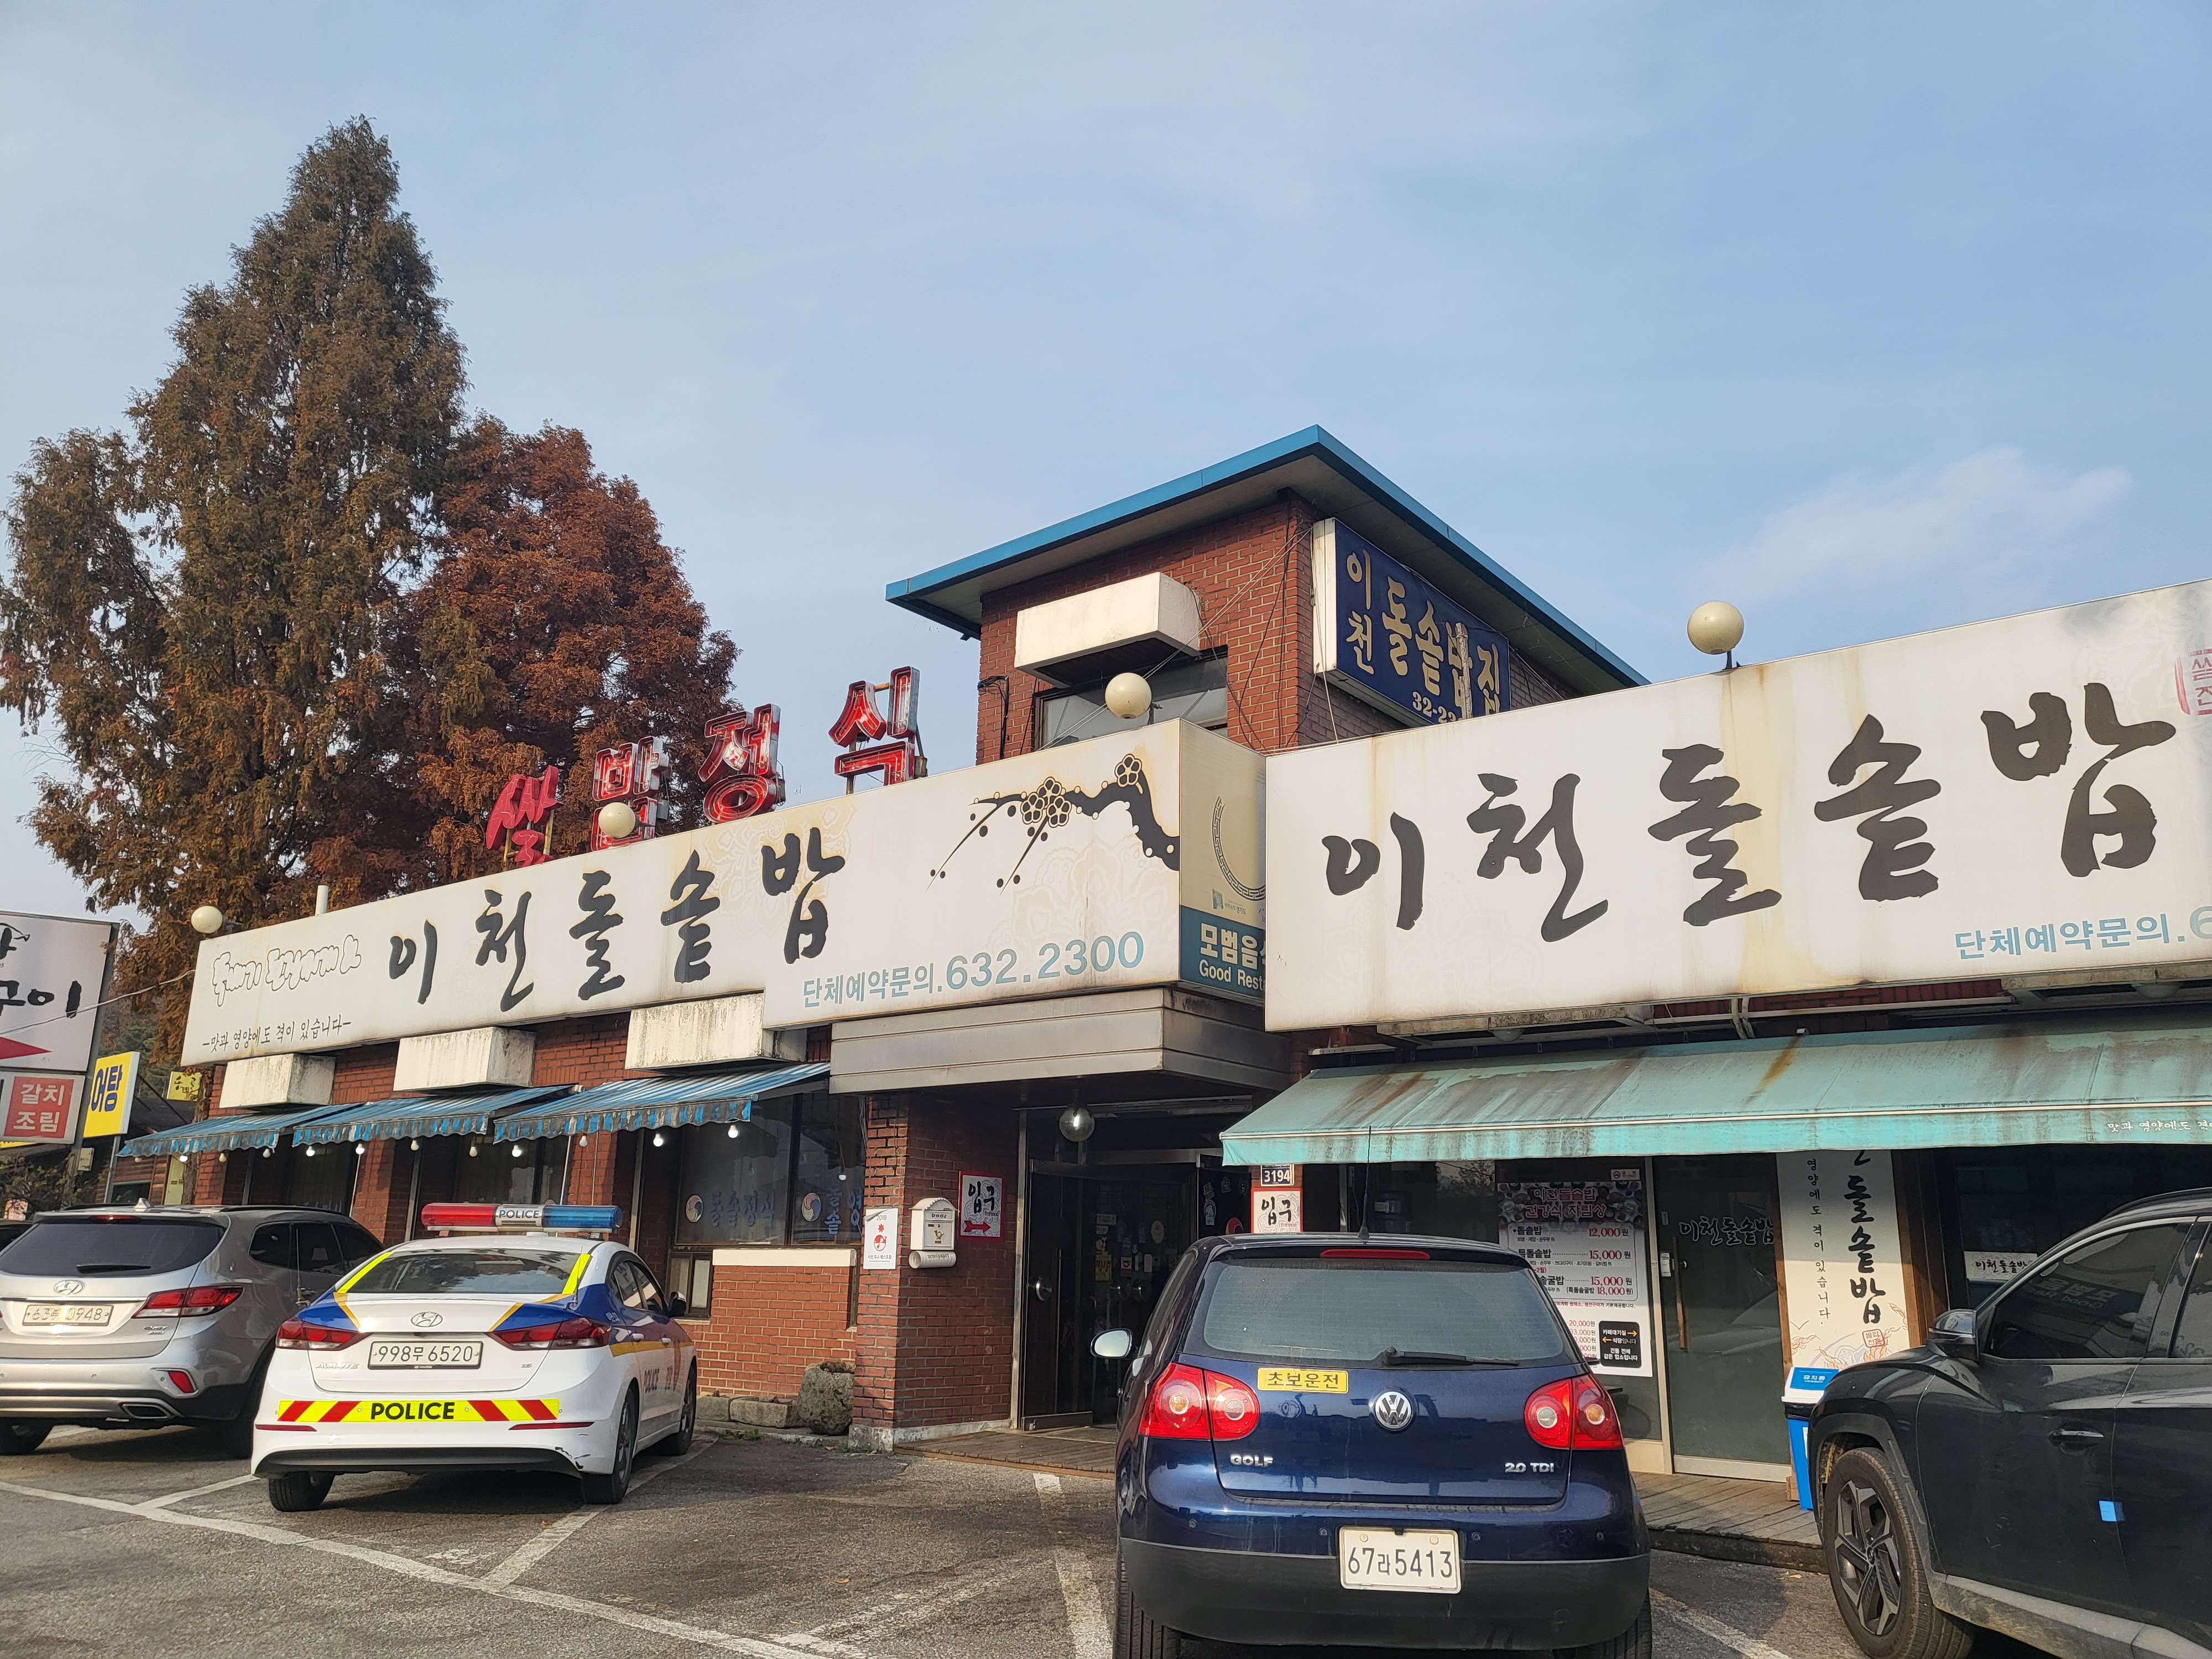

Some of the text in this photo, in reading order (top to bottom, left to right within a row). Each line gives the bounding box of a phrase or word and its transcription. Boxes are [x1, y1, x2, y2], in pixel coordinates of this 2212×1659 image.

[1412, 691, 1462, 724] 32-23
[1323, 682, 2177, 942] 이천돌솥밥
[389, 827, 845, 1012] 이천돌솥밥
[1199, 959, 1265, 992] Good Rest
[233, 1026, 271, 1050] 영양에도
[276, 1021, 295, 1044] 격이
[20, 1083, 65, 1106] 갈치
[13, 1110, 60, 1133] 조림
[2107, 1121, 2134, 1133] 맛과
[2139, 1120, 2192, 1132] 영양에도
[1264, 1170, 1290, 1182] 3194
[1807, 1158, 1822, 1215] 영양에도
[968, 1181, 995, 1214] 입구
[1533, 1187, 1598, 1202] 이천돌솥밥
[498, 1209, 540, 1219] POLICE
[1261, 1196, 1291, 1225] 입구
[1525, 1204, 1607, 1218] 건강식 차림상
[1517, 1225, 1542, 1235] 돌솥밥
[1679, 1216, 1775, 1246] 이천돌솥밥
[1812, 1224, 1824, 1251] 격이
[1267, 1371, 1339, 1390] 초보운전
[370, 1402, 455, 1421] POLICE
[1230, 1453, 1274, 1467] GOLF
[1530, 1462, 1555, 1473] TDI
